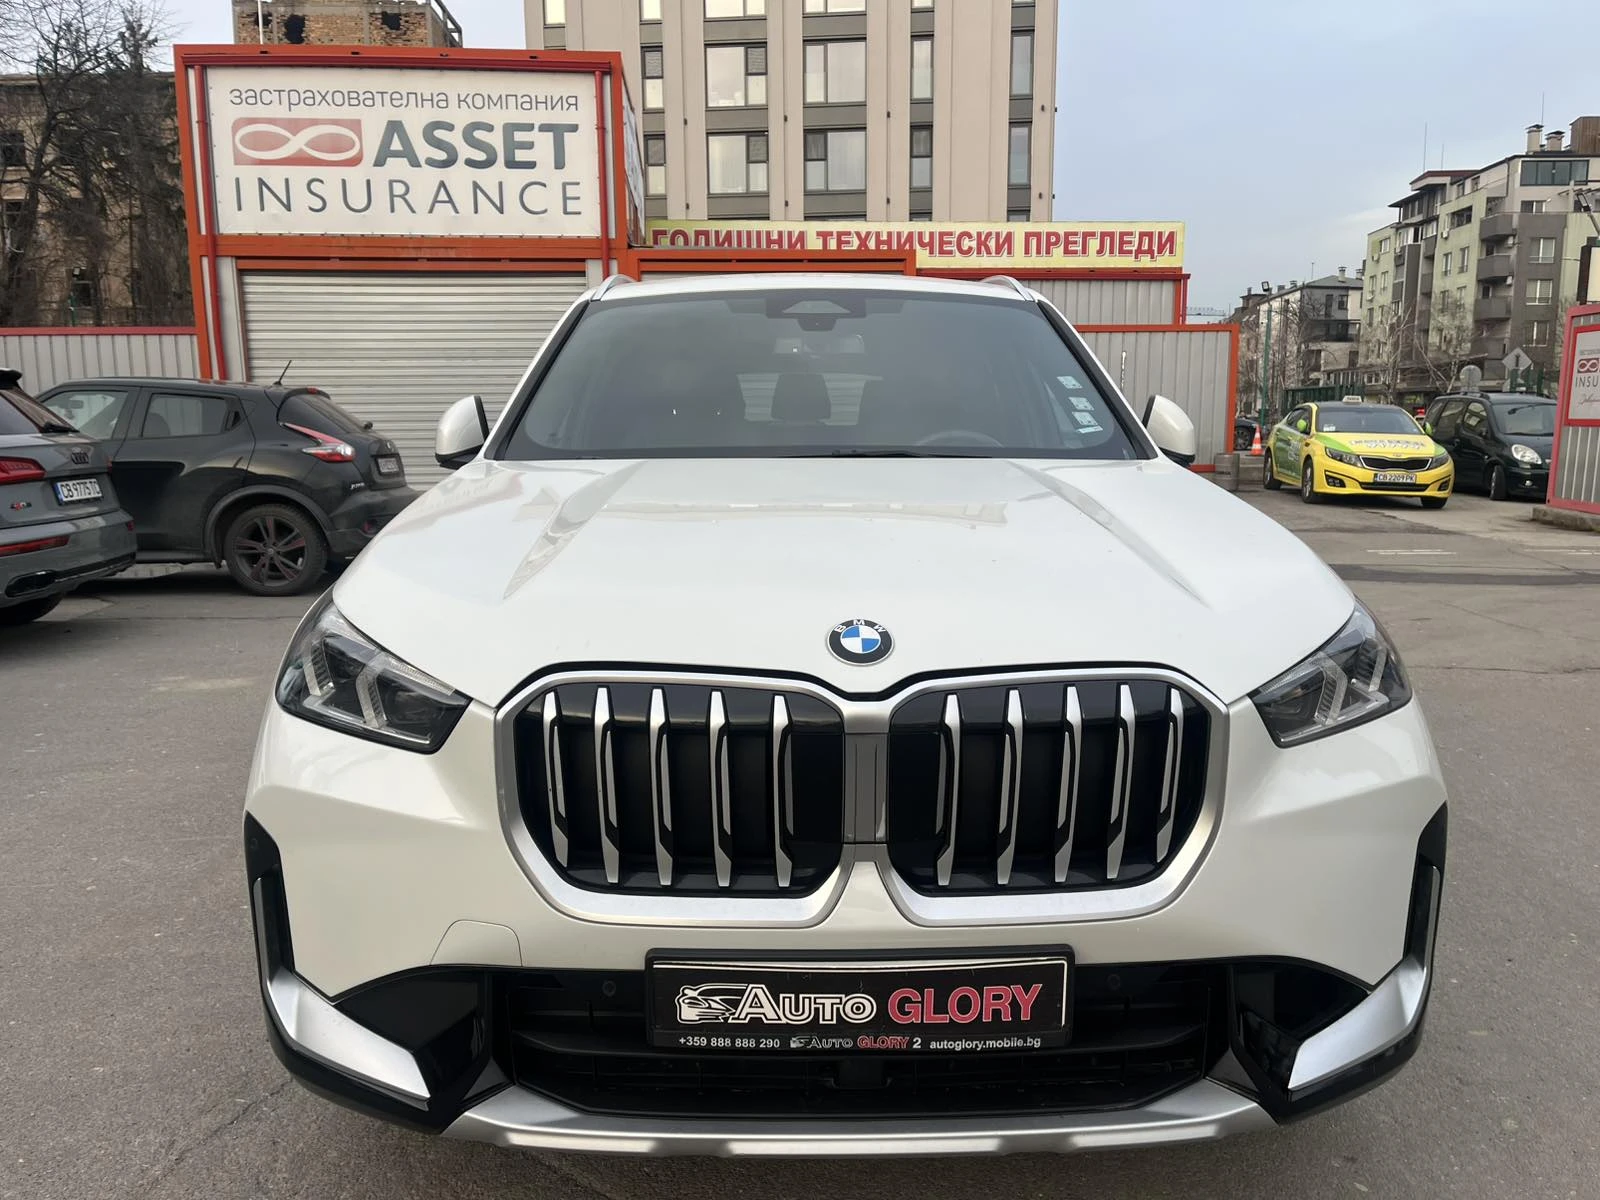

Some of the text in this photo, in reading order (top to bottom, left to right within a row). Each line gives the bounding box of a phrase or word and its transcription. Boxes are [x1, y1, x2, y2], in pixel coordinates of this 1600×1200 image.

[229, 88, 579, 112] застрахователна компания
[373, 119, 579, 170] ASSET
[234, 177, 582, 216] INSURANCE
[815, 229, 1014, 257] ТЕХНИЧЕСКИ
[1023, 230, 1178, 261] ПРЕГЛЕДИ
[834, 619, 887, 633] BMW
[887, 984, 1043, 1024] GLORY
[679, 1036, 707, 1047] +359
[710, 1037, 731, 1047] 888
[735, 1038, 756, 1048] 888
[759, 1038, 780, 1048] 290
[857, 1035, 909, 1048] GLORY
[913, 1037, 922, 1048] 2
[929, 1036, 1041, 1051] autoglory.mobile.bg
